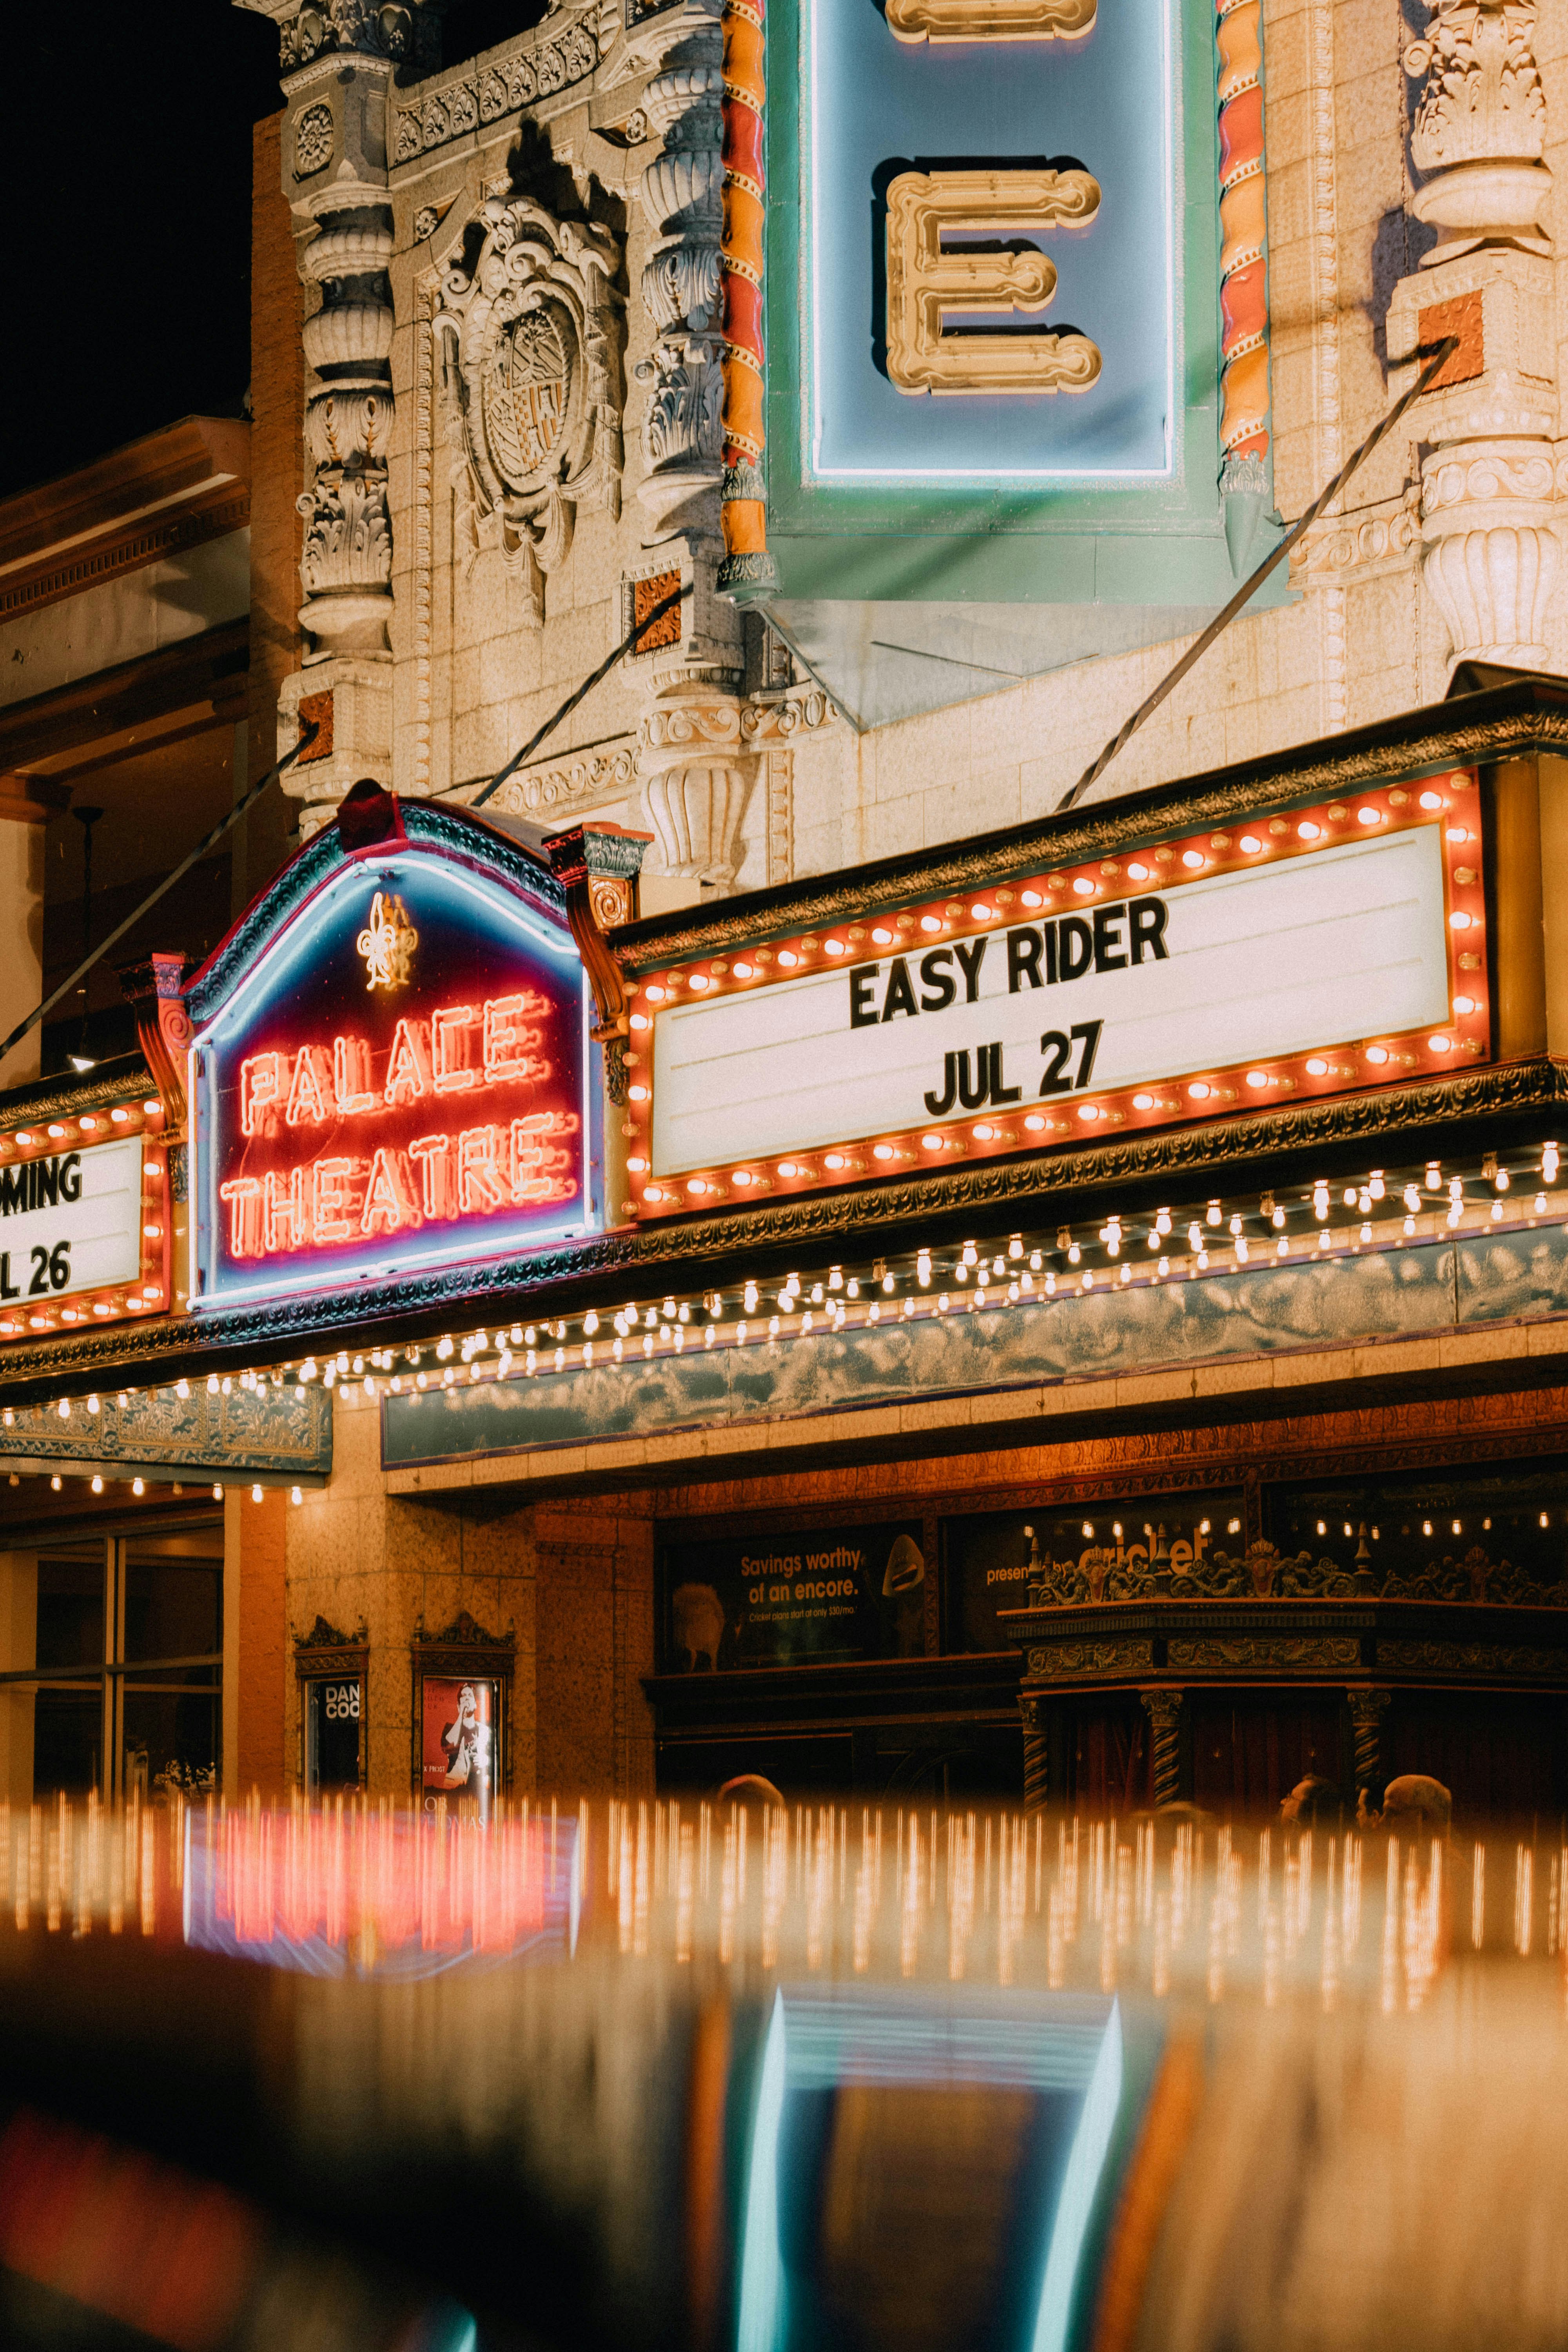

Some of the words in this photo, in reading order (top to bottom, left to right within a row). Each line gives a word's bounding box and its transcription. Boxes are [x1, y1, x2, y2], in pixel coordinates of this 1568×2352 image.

[849, 936, 989, 1029] EASY
[1007, 896, 1169, 994] RIDER
[241, 993, 530, 1137] PALACE
[924, 1041, 1022, 1116] JUL
[1039, 1019, 1104, 1096] 27
[220, 1111, 555, 1257] THEATRE
[28, 1240, 72, 1295] 26
[741, 1553, 802, 1578] Savings
[806, 1546, 861, 1571] worthy
[987, 1562, 1047, 1586] presen
[749, 1582, 765, 1604] of
[769, 1584, 790, 1602] an
[795, 1579, 859, 1601] encore.
[749, 1611, 771, 1622] Cricket
[772, 1611, 789, 1622] plans
[790, 1610, 804, 1619] start
[805, 1608, 812, 1618] at
[813, 1608, 828, 1619] only
